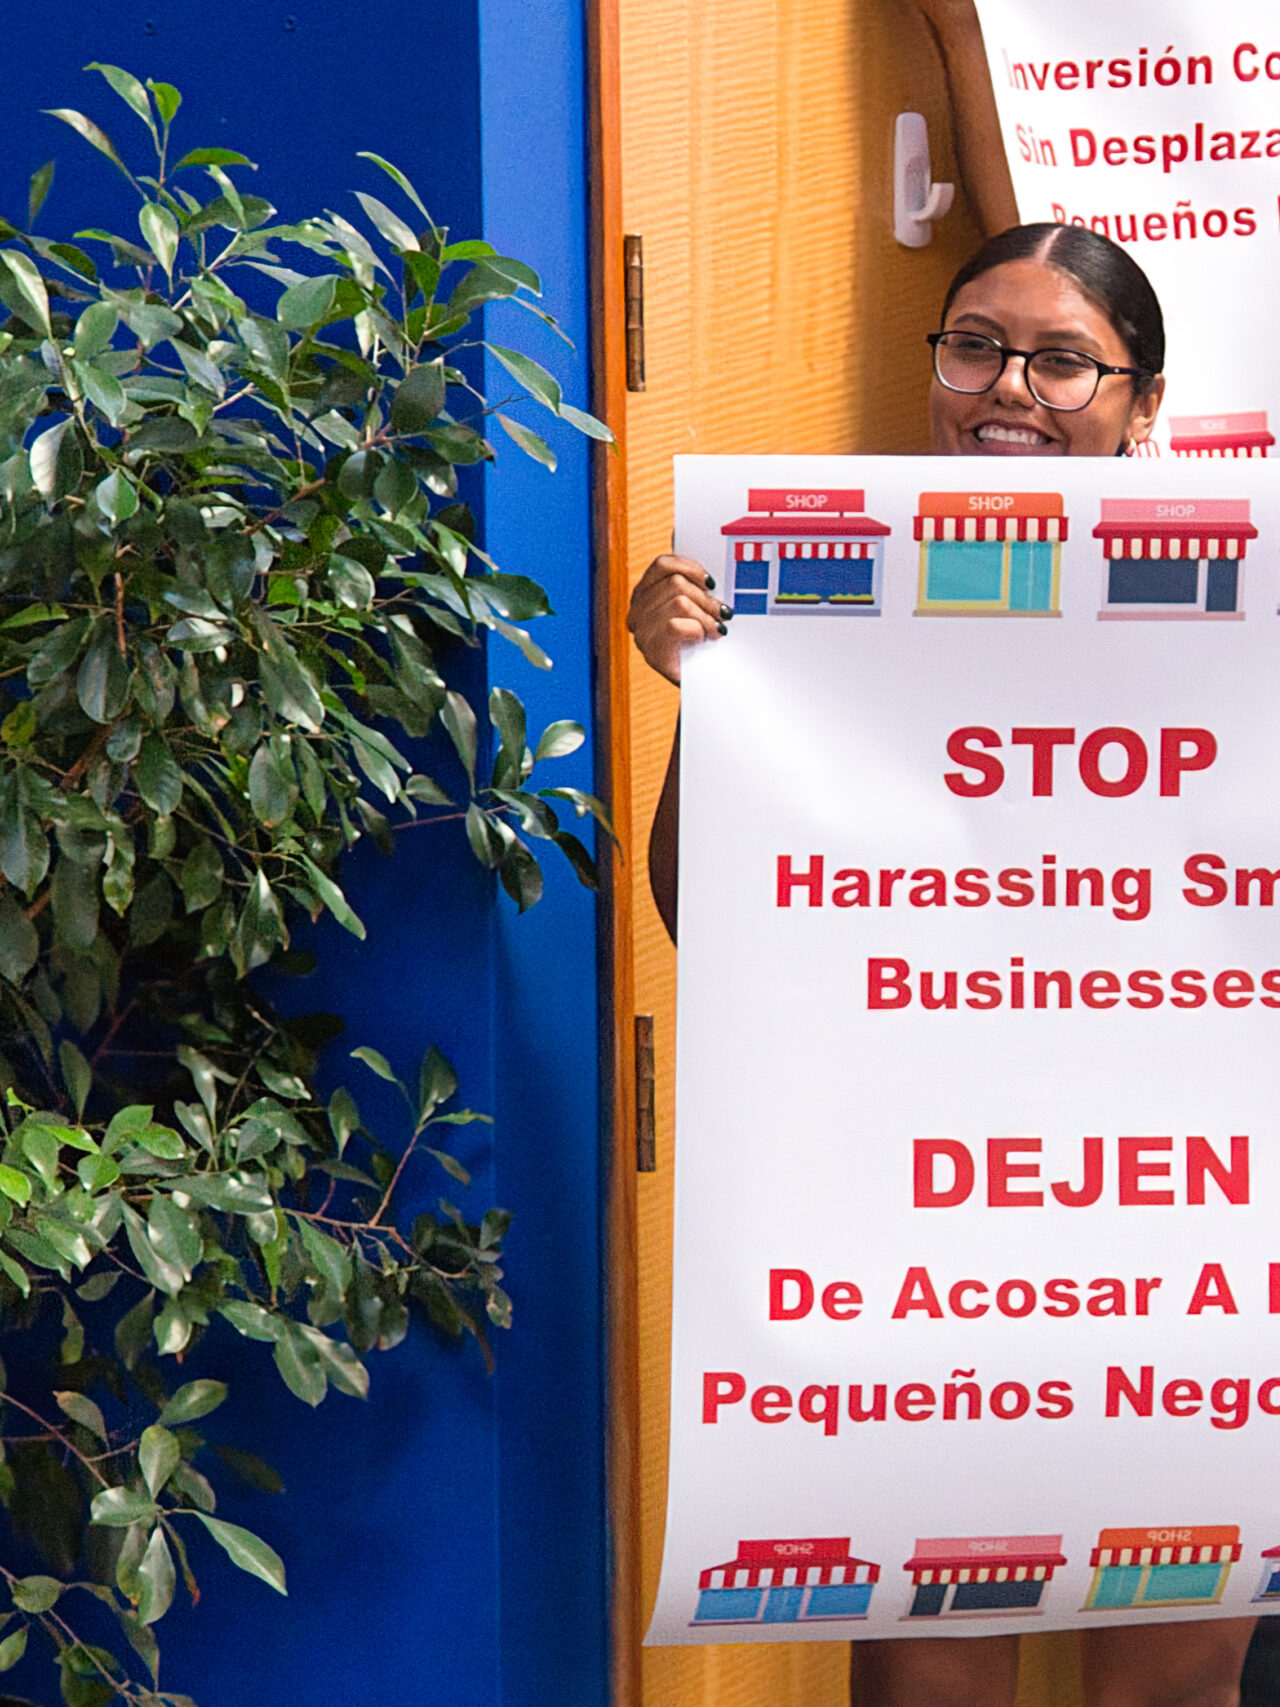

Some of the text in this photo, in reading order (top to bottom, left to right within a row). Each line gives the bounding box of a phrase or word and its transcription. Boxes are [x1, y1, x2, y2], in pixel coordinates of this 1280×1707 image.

[1003, 45, 1213, 91] Inversión
[1015, 122, 1058, 168] Sin
[785, 494, 828, 509] SHOP
[968, 496, 1014, 511] SHOP
[1155, 504, 1196, 518] SHOP
[944, 726, 1218, 799] STOP
[776, 854, 1152, 922] Harassing
[912, 1135, 1251, 1209] DEJEN
[768, 1268, 864, 1322] De
[891, 1266, 1163, 1320] Acosar
[1186, 1262, 1240, 1316] A
[702, 1368, 1074, 1437] Pequeños
